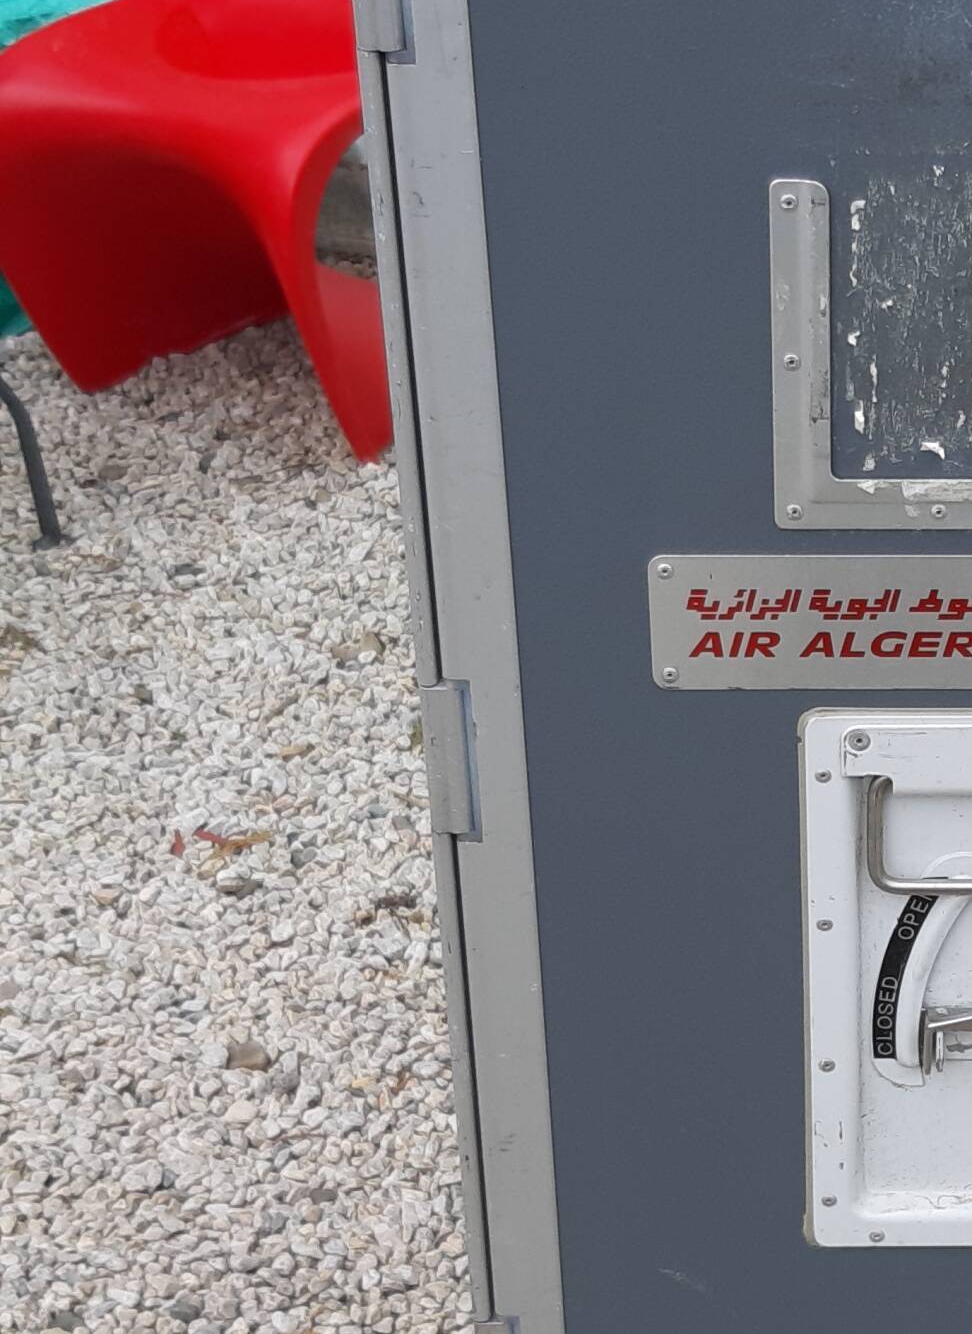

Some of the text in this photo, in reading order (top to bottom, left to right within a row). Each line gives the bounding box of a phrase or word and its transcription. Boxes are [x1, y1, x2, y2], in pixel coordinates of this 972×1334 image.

[688, 631, 781, 658] AIR
[897, 895, 934, 941] OPE
[877, 976, 899, 1056] CLOSED
